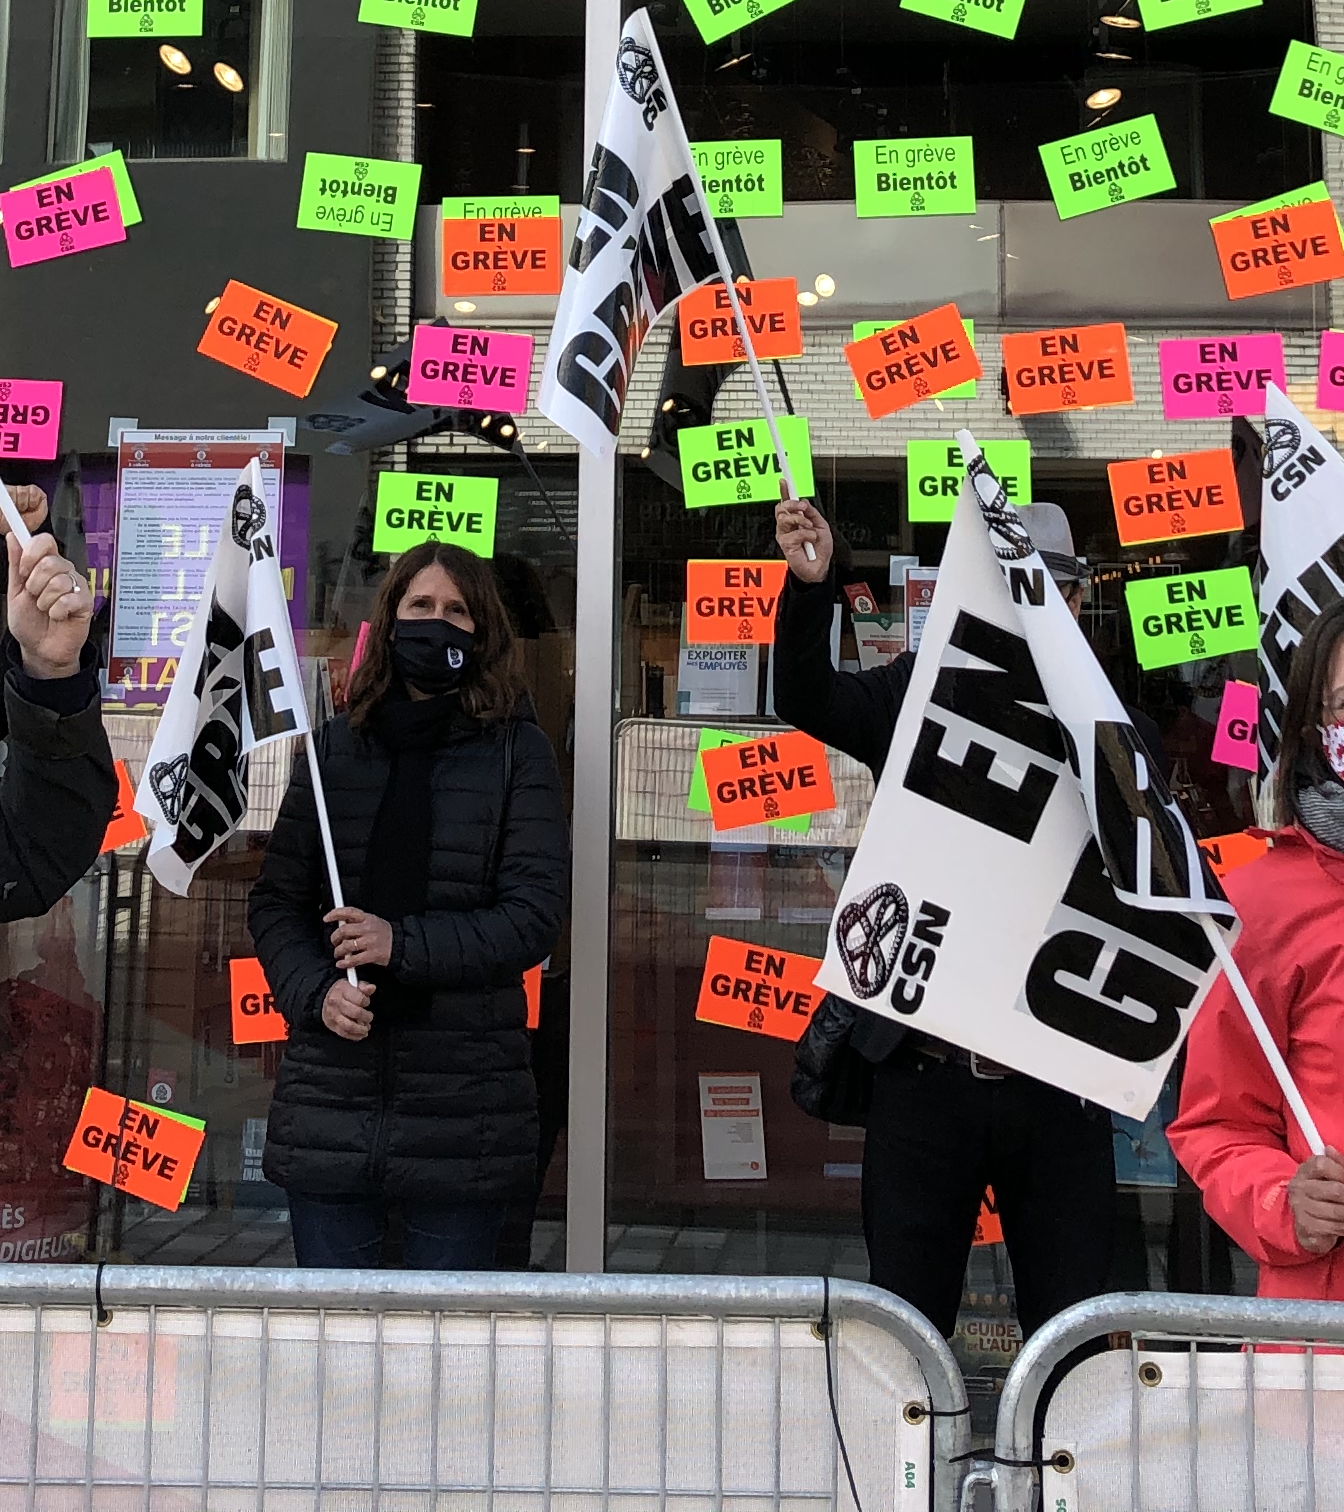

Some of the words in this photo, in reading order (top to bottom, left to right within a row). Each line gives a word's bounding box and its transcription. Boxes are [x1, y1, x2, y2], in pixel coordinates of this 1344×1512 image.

[875, 145, 899, 165] En
[905, 143, 956, 168] grève
[318, 178, 398, 205] Bientôt
[876, 170, 958, 192] Bientôt
[35, 181, 75, 209] EN
[15, 201, 110, 241] GRÈVE
[315, 204, 365, 227] grève
[370, 211, 394, 233] En
[479, 222, 516, 243] EN
[451, 245, 546, 271] GRÈVE
[253, 300, 292, 331] EN
[217, 316, 308, 370] GRÈVE
[451, 333, 490, 357] EN
[879, 325, 920, 356] EN
[1040, 333, 1080, 357] EN
[420, 358, 517, 388] GRÈVE
[865, 339, 961, 391] GRÈVE
[1015, 358, 1116, 388] GRÈVE
[154, 433, 187, 443] Message
[1147, 460, 1187, 484] EN
[1270, 444, 1328, 503] CSN
[415, 480, 454, 503] EN
[1123, 485, 1224, 517] GRÈVE
[385, 505, 483, 534] GRÈVE
[1165, 579, 1208, 605] EN
[1142, 604, 1245, 638] GRÈVE
[687, 650, 747, 660] EXPLOITER
[698, 661, 748, 671] EMPLOYÉS
[902, 606, 1067, 847] EN
[738, 741, 780, 770] EN
[716, 764, 817, 804] GRÈVE
[889, 899, 952, 1017] CSN
[966, 1322, 1017, 1338] GUIDE
